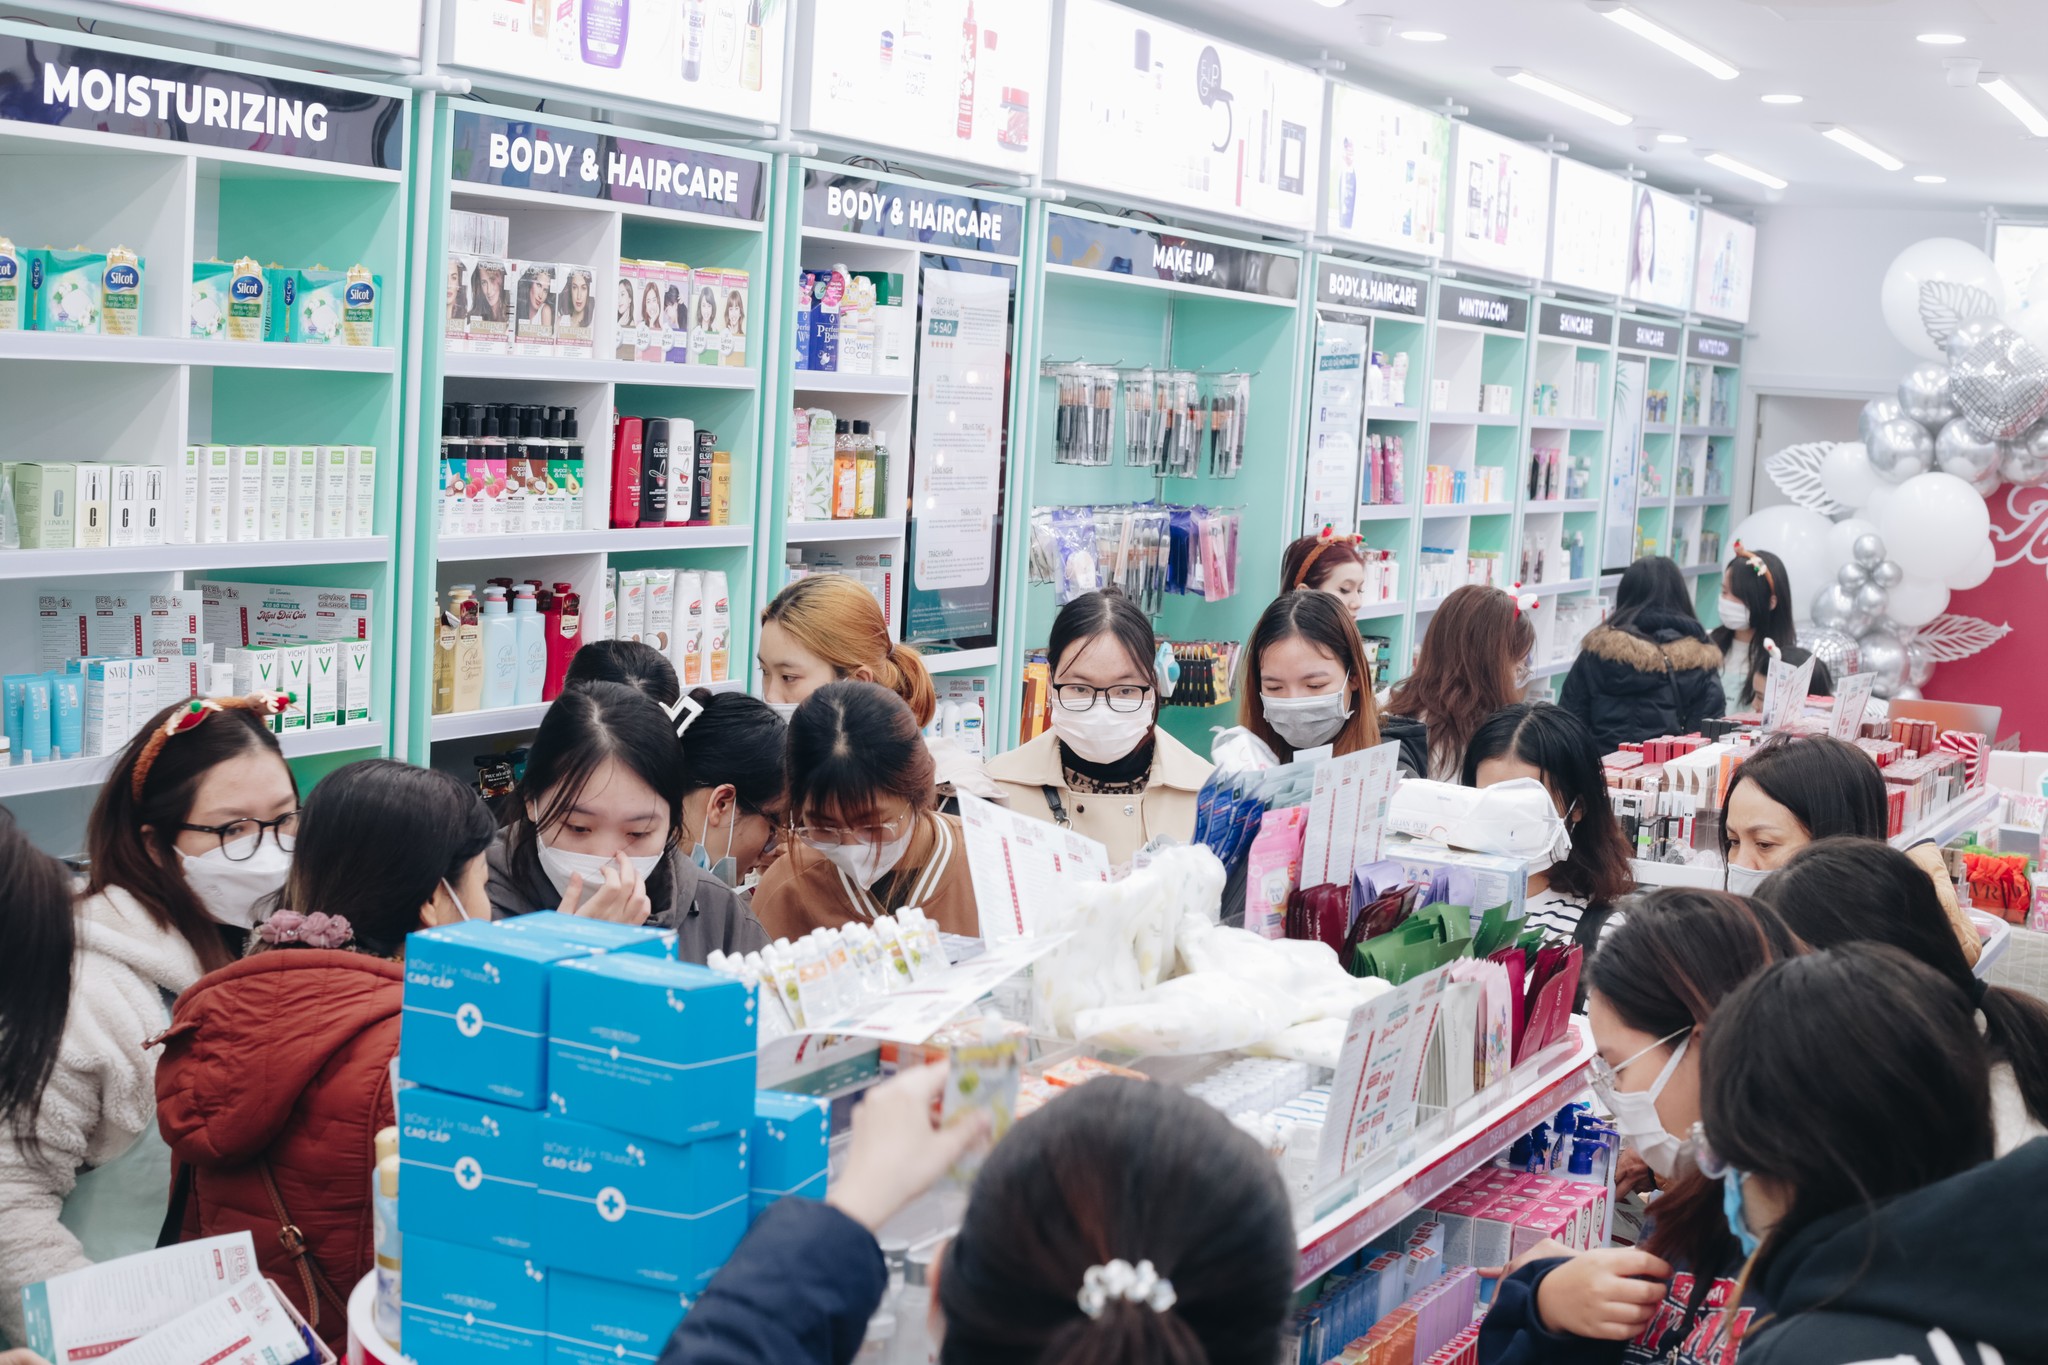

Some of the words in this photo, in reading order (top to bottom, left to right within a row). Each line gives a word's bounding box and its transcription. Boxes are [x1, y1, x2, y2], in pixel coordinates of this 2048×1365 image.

[43, 62, 329, 142] MOISTURIZING
[489, 132, 574, 178] BODY
[579, 147, 599, 182] &
[607, 151, 739, 203] HAIRCARE
[827, 186, 887, 223] BODY
[890, 197, 904, 226] &
[909, 200, 1002, 241] HAIRCARE
[0, 263, 11, 275] cot
[1152, 244, 1193, 274] MAKE
[1195, 251, 1215, 276] UP
[110, 272, 134, 285] Silcot
[236, 282, 258, 294] Silcot
[350, 288, 370, 300] Silcot
[1328, 272, 1358, 297] BODY
[1360, 278, 1368, 299] &
[1370, 281, 1418, 308] HAIRCARE
[1458, 296, 1509, 322] MINT07.COM
[934, 322, 939, 333] 5
[940, 322, 953, 335] SAO
[1559, 313, 1594, 336] SKINCARE
[1636, 326, 1665, 348] SKINCARE
[287, 650, 306, 658] VICHY
[314, 646, 336, 655] VICHY
[108, 667, 127, 679] SVR
[136, 664, 156, 677] SVR
[10, 683, 18, 718] CLEAR
[31, 687, 40, 720] CLEAR
[60, 683, 68, 717] CLEAR
[406, 972, 430, 986] CAO
[1526, 1102, 1542, 1122] DEAL
[404, 1126, 427, 1140] CAO
[1489, 1127, 1506, 1148] DEAL
[542, 1155, 568, 1170] CAO
[1447, 1152, 1465, 1176] DEAL
[1596, 1200, 1604, 1228] Veet
[1354, 1214, 1375, 1240] DEAL
[234, 1247, 248, 1277] DEAL
[1300, 1250, 1323, 1275] DEAL
